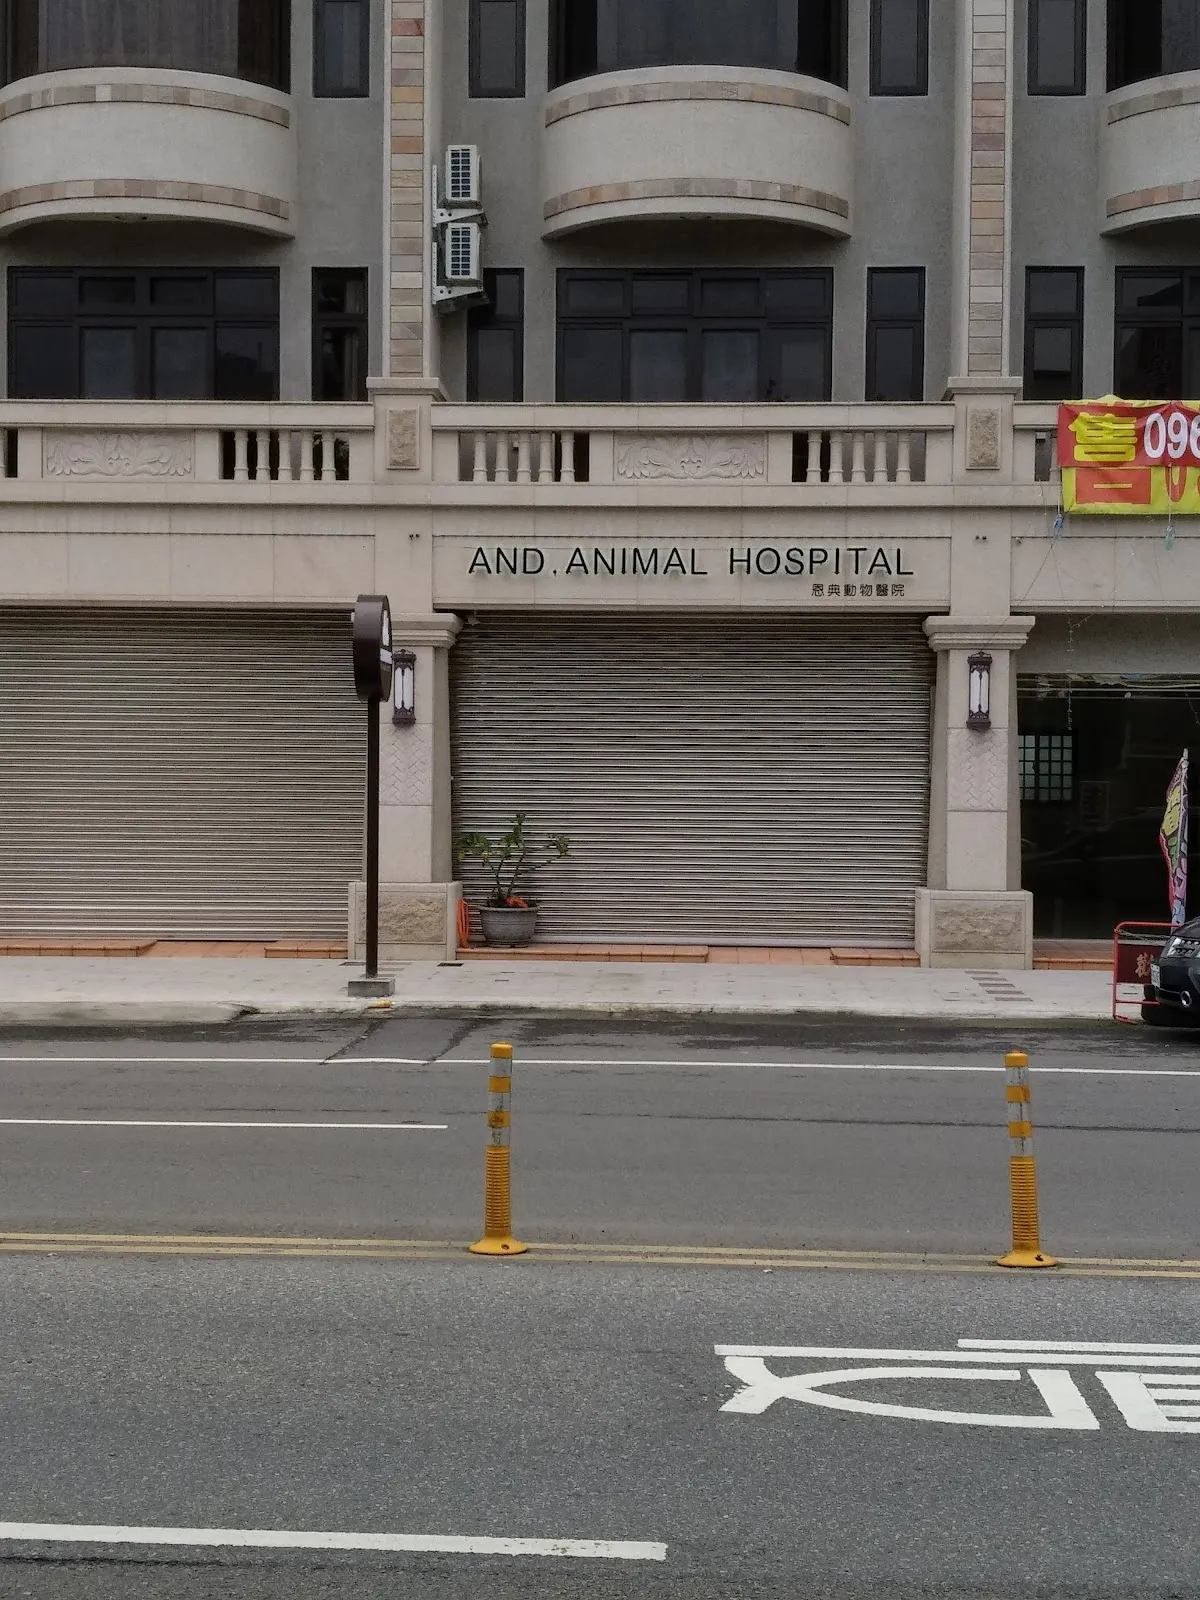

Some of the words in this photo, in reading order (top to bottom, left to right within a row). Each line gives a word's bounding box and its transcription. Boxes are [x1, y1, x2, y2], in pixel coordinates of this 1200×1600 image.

[728, 547, 914, 576] HOSPITAL
[811, 583, 905, 597] 恩典動物醫院
